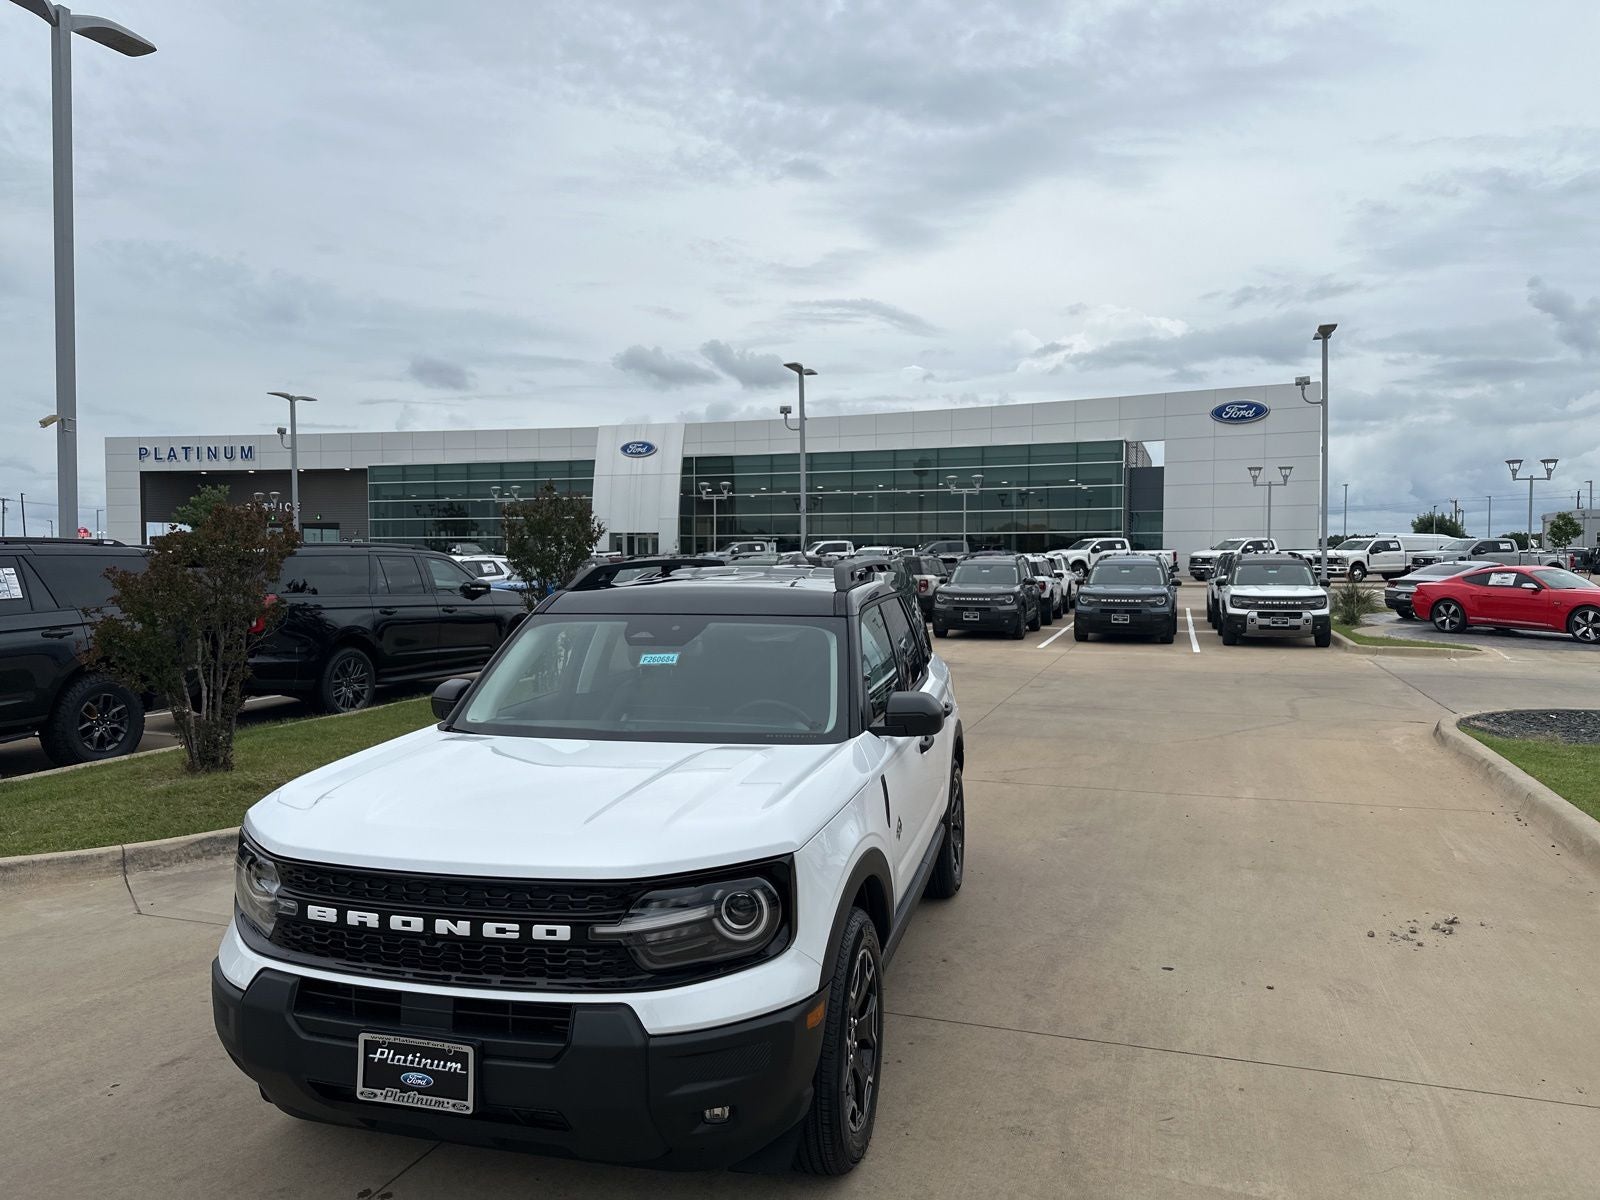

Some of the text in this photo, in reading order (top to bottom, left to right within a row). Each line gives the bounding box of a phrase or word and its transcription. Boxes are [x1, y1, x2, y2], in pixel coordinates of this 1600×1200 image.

[1222, 404, 1256, 418] Ford
[138, 445, 253, 461] PLATINUM
[642, 655, 676, 663] F260684
[307, 904, 571, 941] BRONCO
[368, 1048, 467, 1074] Platinum
[406, 1074, 428, 1086] Ford
